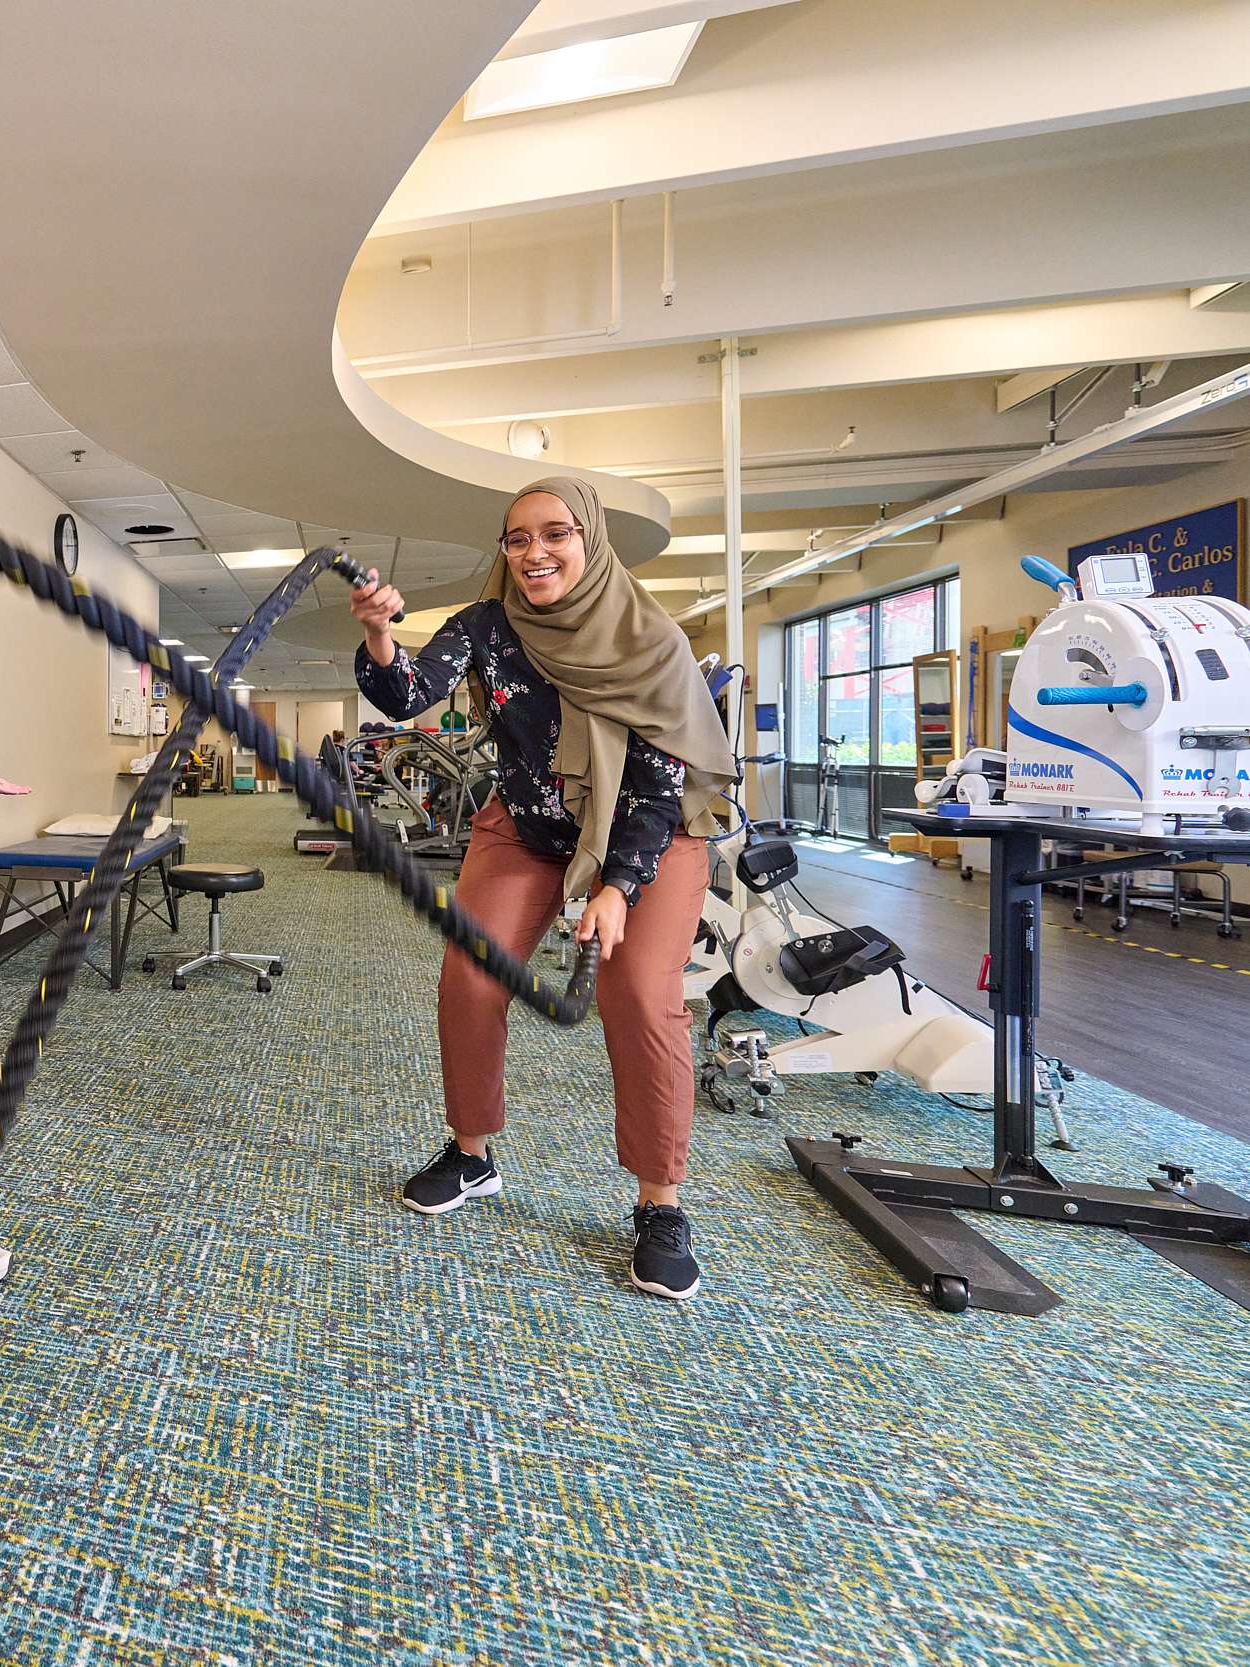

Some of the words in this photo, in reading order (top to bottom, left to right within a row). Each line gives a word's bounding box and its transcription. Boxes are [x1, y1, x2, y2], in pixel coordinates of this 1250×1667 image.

[1149, 532, 1166, 553] C.
[1174, 527, 1188, 547] &
[1168, 545, 1233, 573] Carlos
[1021, 763, 1074, 779] MONARK
[1030, 782, 1054, 791] Trainer
